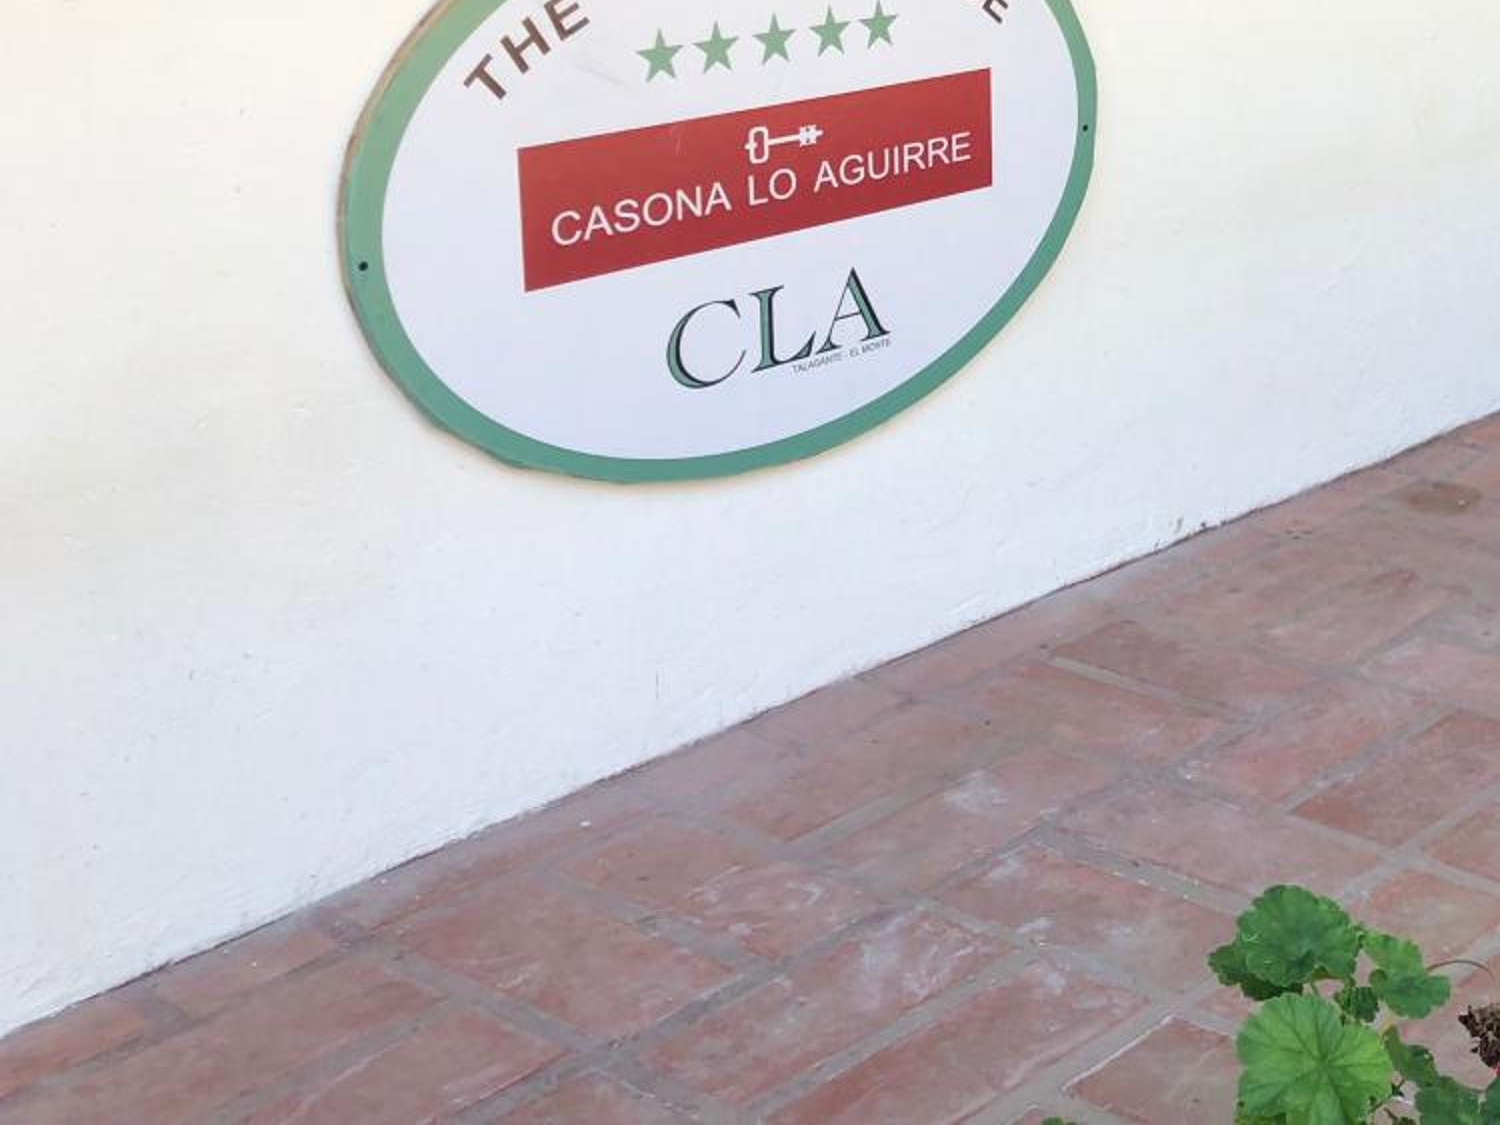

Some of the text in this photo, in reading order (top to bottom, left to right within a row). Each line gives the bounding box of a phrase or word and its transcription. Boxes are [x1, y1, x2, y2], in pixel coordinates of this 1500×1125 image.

[551, 131, 972, 247] CASONA LO AGUIRRE
[666, 266, 891, 389] CLA
